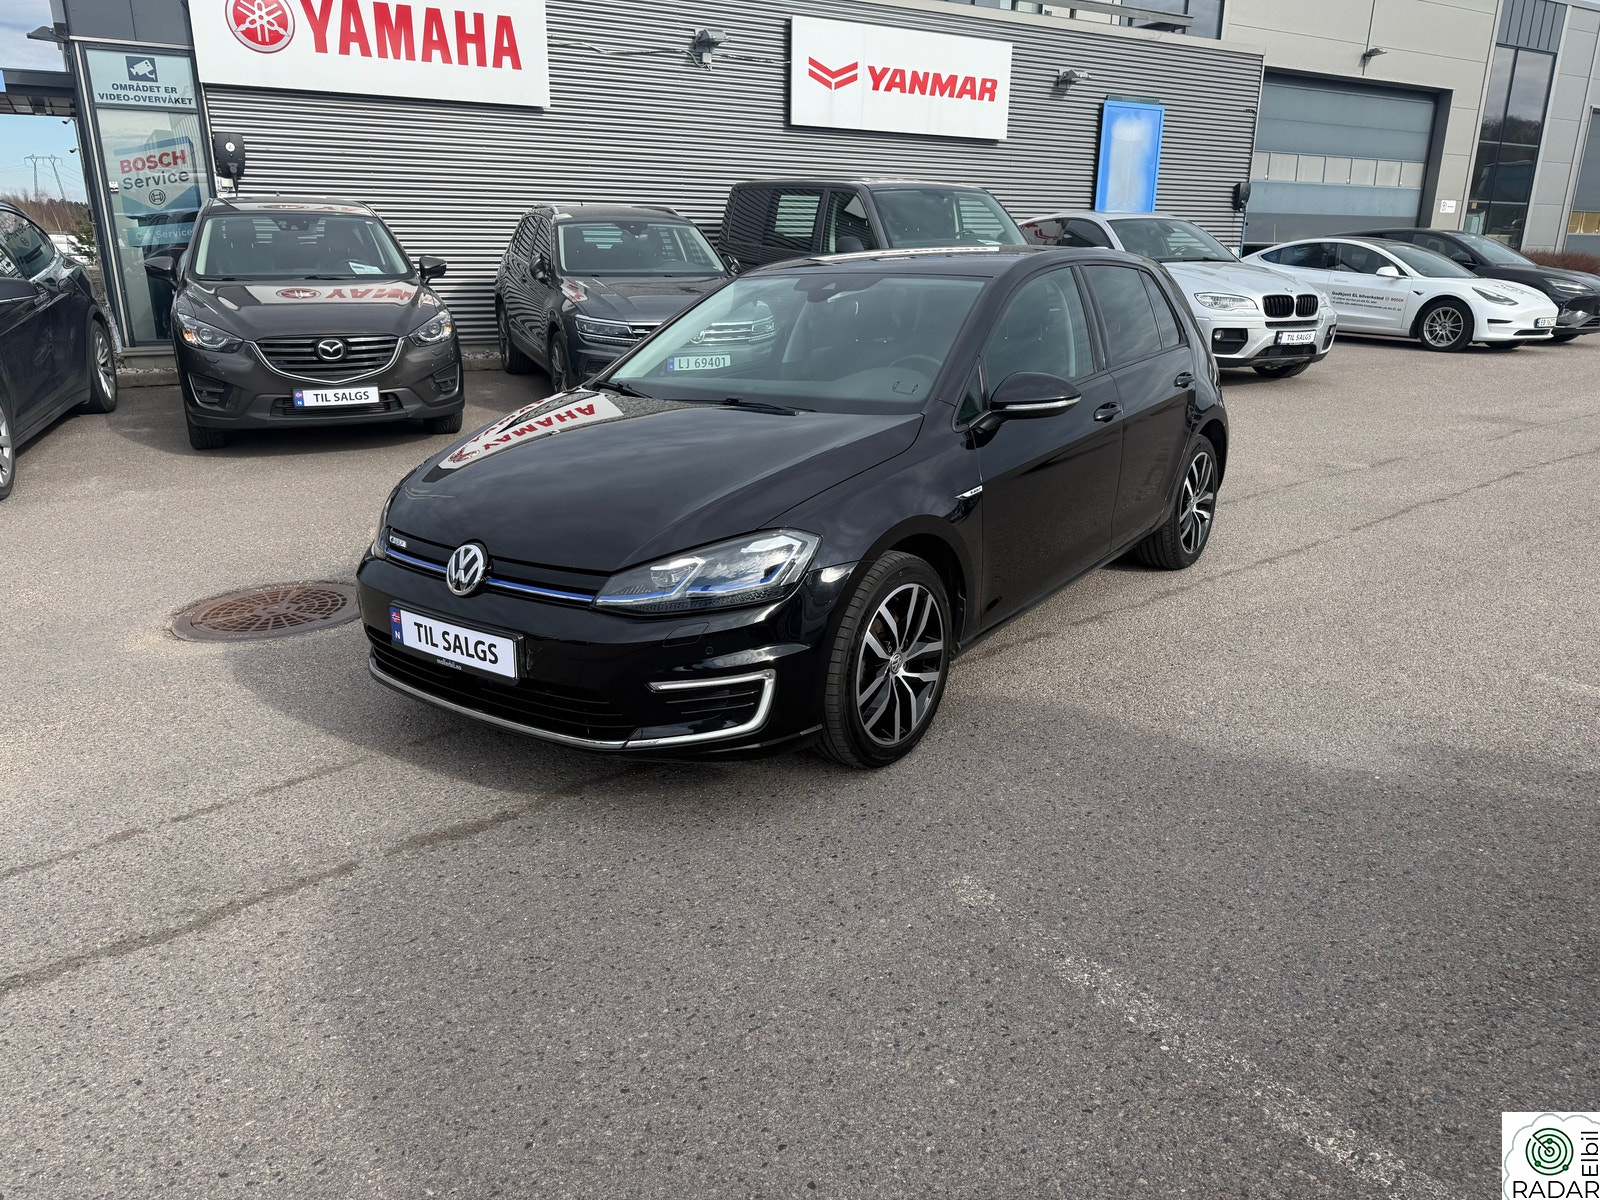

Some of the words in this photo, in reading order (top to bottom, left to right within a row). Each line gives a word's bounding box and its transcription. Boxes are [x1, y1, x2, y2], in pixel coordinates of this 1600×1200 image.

[300, 0, 523, 71] YAMAHA
[111, 82, 161, 94] OMRÅDET
[164, 86, 178, 94] ER
[867, 65, 998, 102] YANMAR
[98, 92, 193, 106] VIDEO-OVERVÅKET
[119, 149, 187, 174] BOSCH
[122, 171, 190, 190] Service
[156, 228, 193, 239] Service
[1296, 333, 1312, 341] SALGS
[678, 358, 690, 369] LJ
[694, 356, 726, 368] 69401
[313, 393, 331, 403] TIL
[333, 391, 370, 402] SALGS
[413, 621, 438, 648] TIL
[441, 630, 499, 665] SALGS
